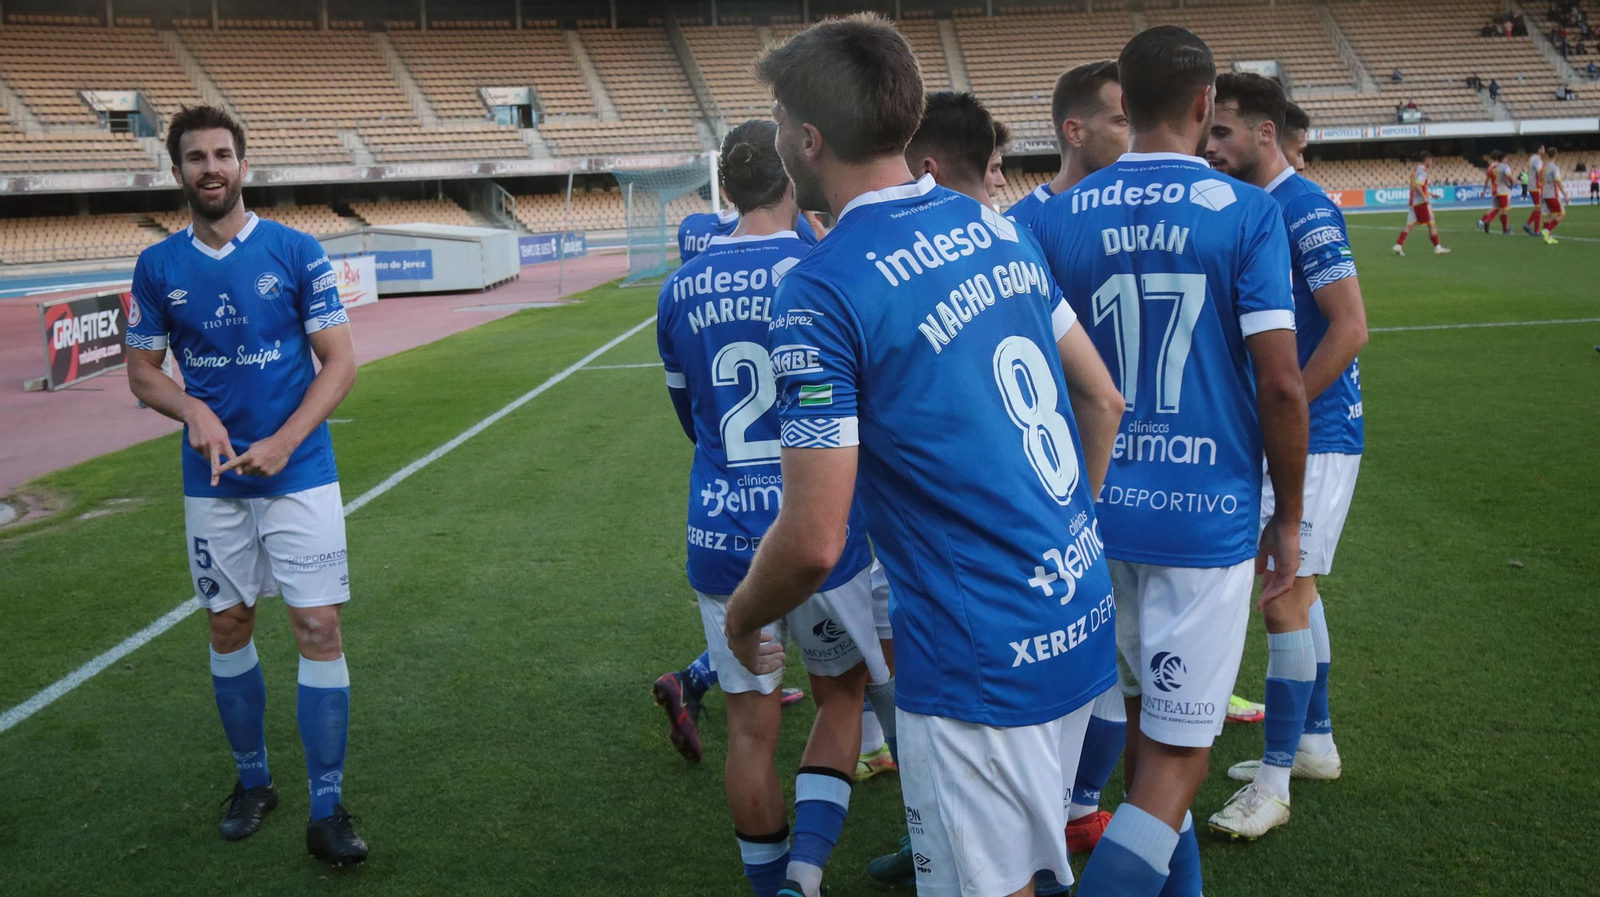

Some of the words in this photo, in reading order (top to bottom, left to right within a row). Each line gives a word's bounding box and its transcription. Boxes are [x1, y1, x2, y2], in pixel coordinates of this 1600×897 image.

[1324, 129, 1359, 137] HIPOTELS
[1382, 127, 1417, 135] HIPOTELS
[1072, 180, 1185, 214] indeso
[866, 222, 992, 287] indeso
[1101, 220, 1190, 256] DURÁN
[390, 261, 401, 269] de
[403, 260, 426, 270] Jerez
[673, 266, 768, 302] indeso
[53, 308, 120, 350] GRAFITEX
[202, 320, 222, 329] TIO
[225, 316, 249, 326] PEPE
[687, 296, 773, 335] MARCEL
[775, 314, 785, 329] de
[785, 313, 813, 329] Jerez
[918, 273, 996, 355] NACHO
[183, 347, 232, 368] Promo
[1091, 272, 1207, 414] 17
[711, 341, 781, 468] 2
[993, 335, 1079, 506] 8
[1128, 420, 1170, 434] clínicas
[1109, 485, 1237, 514] DEPORTIVO
[193, 536, 213, 571] 5
[687, 524, 727, 551] XEREZ
[1008, 614, 1088, 668] XEREZ
[1168, 717, 1214, 725] ESPECIALIDADES
